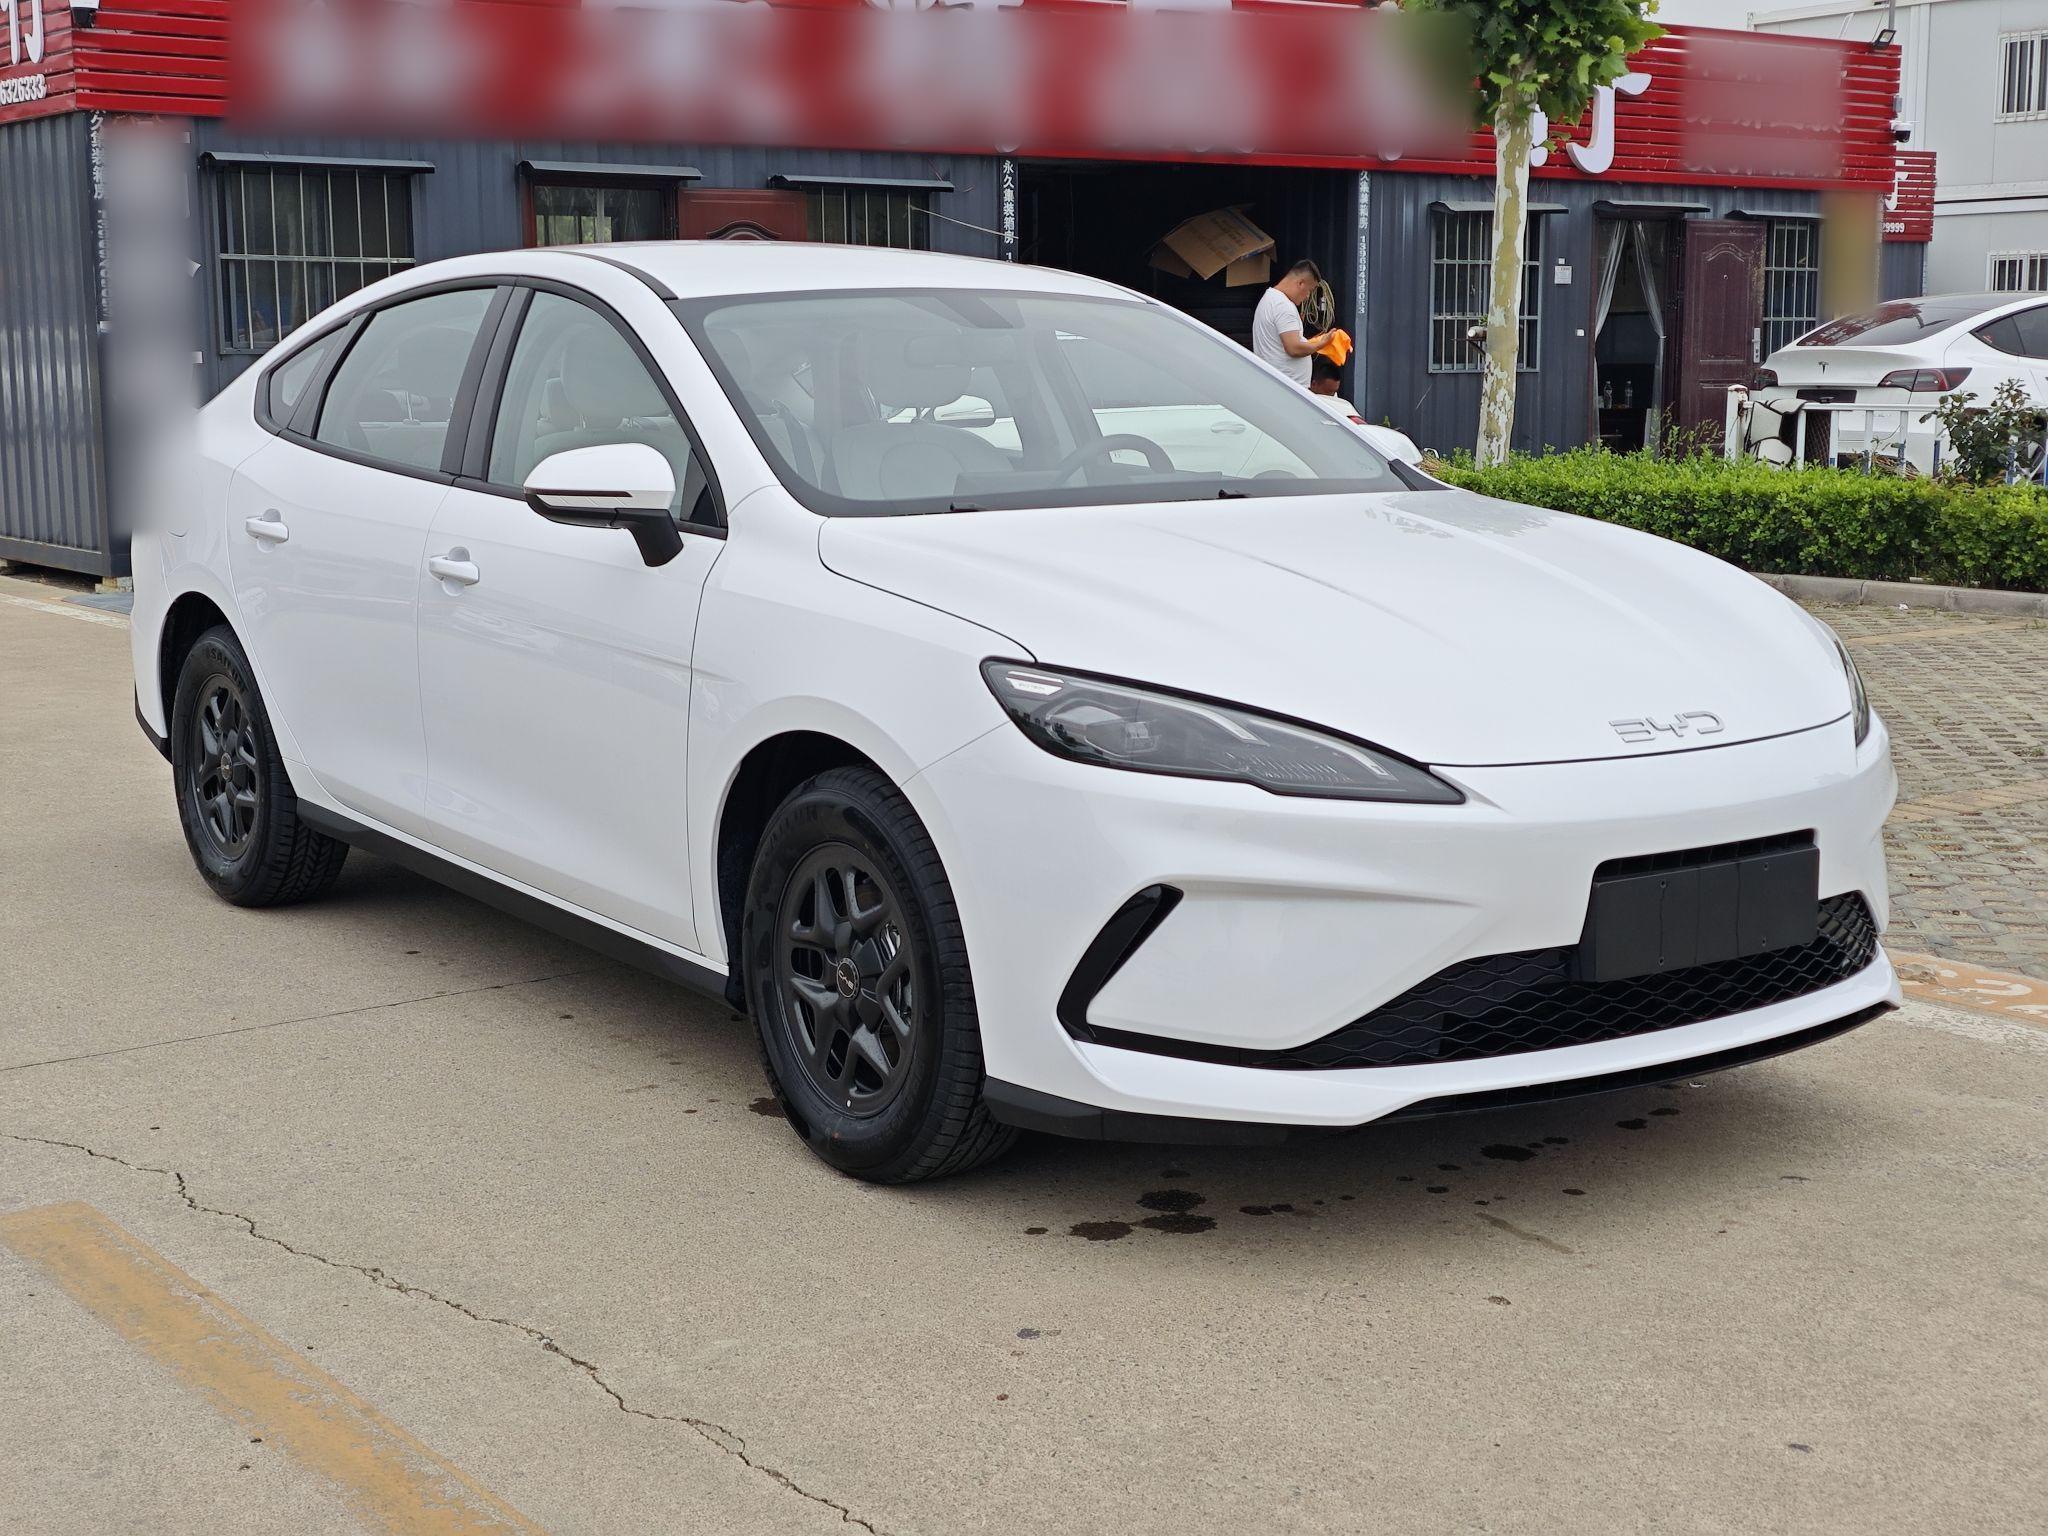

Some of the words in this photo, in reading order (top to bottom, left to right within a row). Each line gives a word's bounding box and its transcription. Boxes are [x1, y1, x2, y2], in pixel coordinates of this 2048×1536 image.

[1003, 160, 1015, 244] 永久集装箱房
[1608, 710, 1725, 743] BYD
